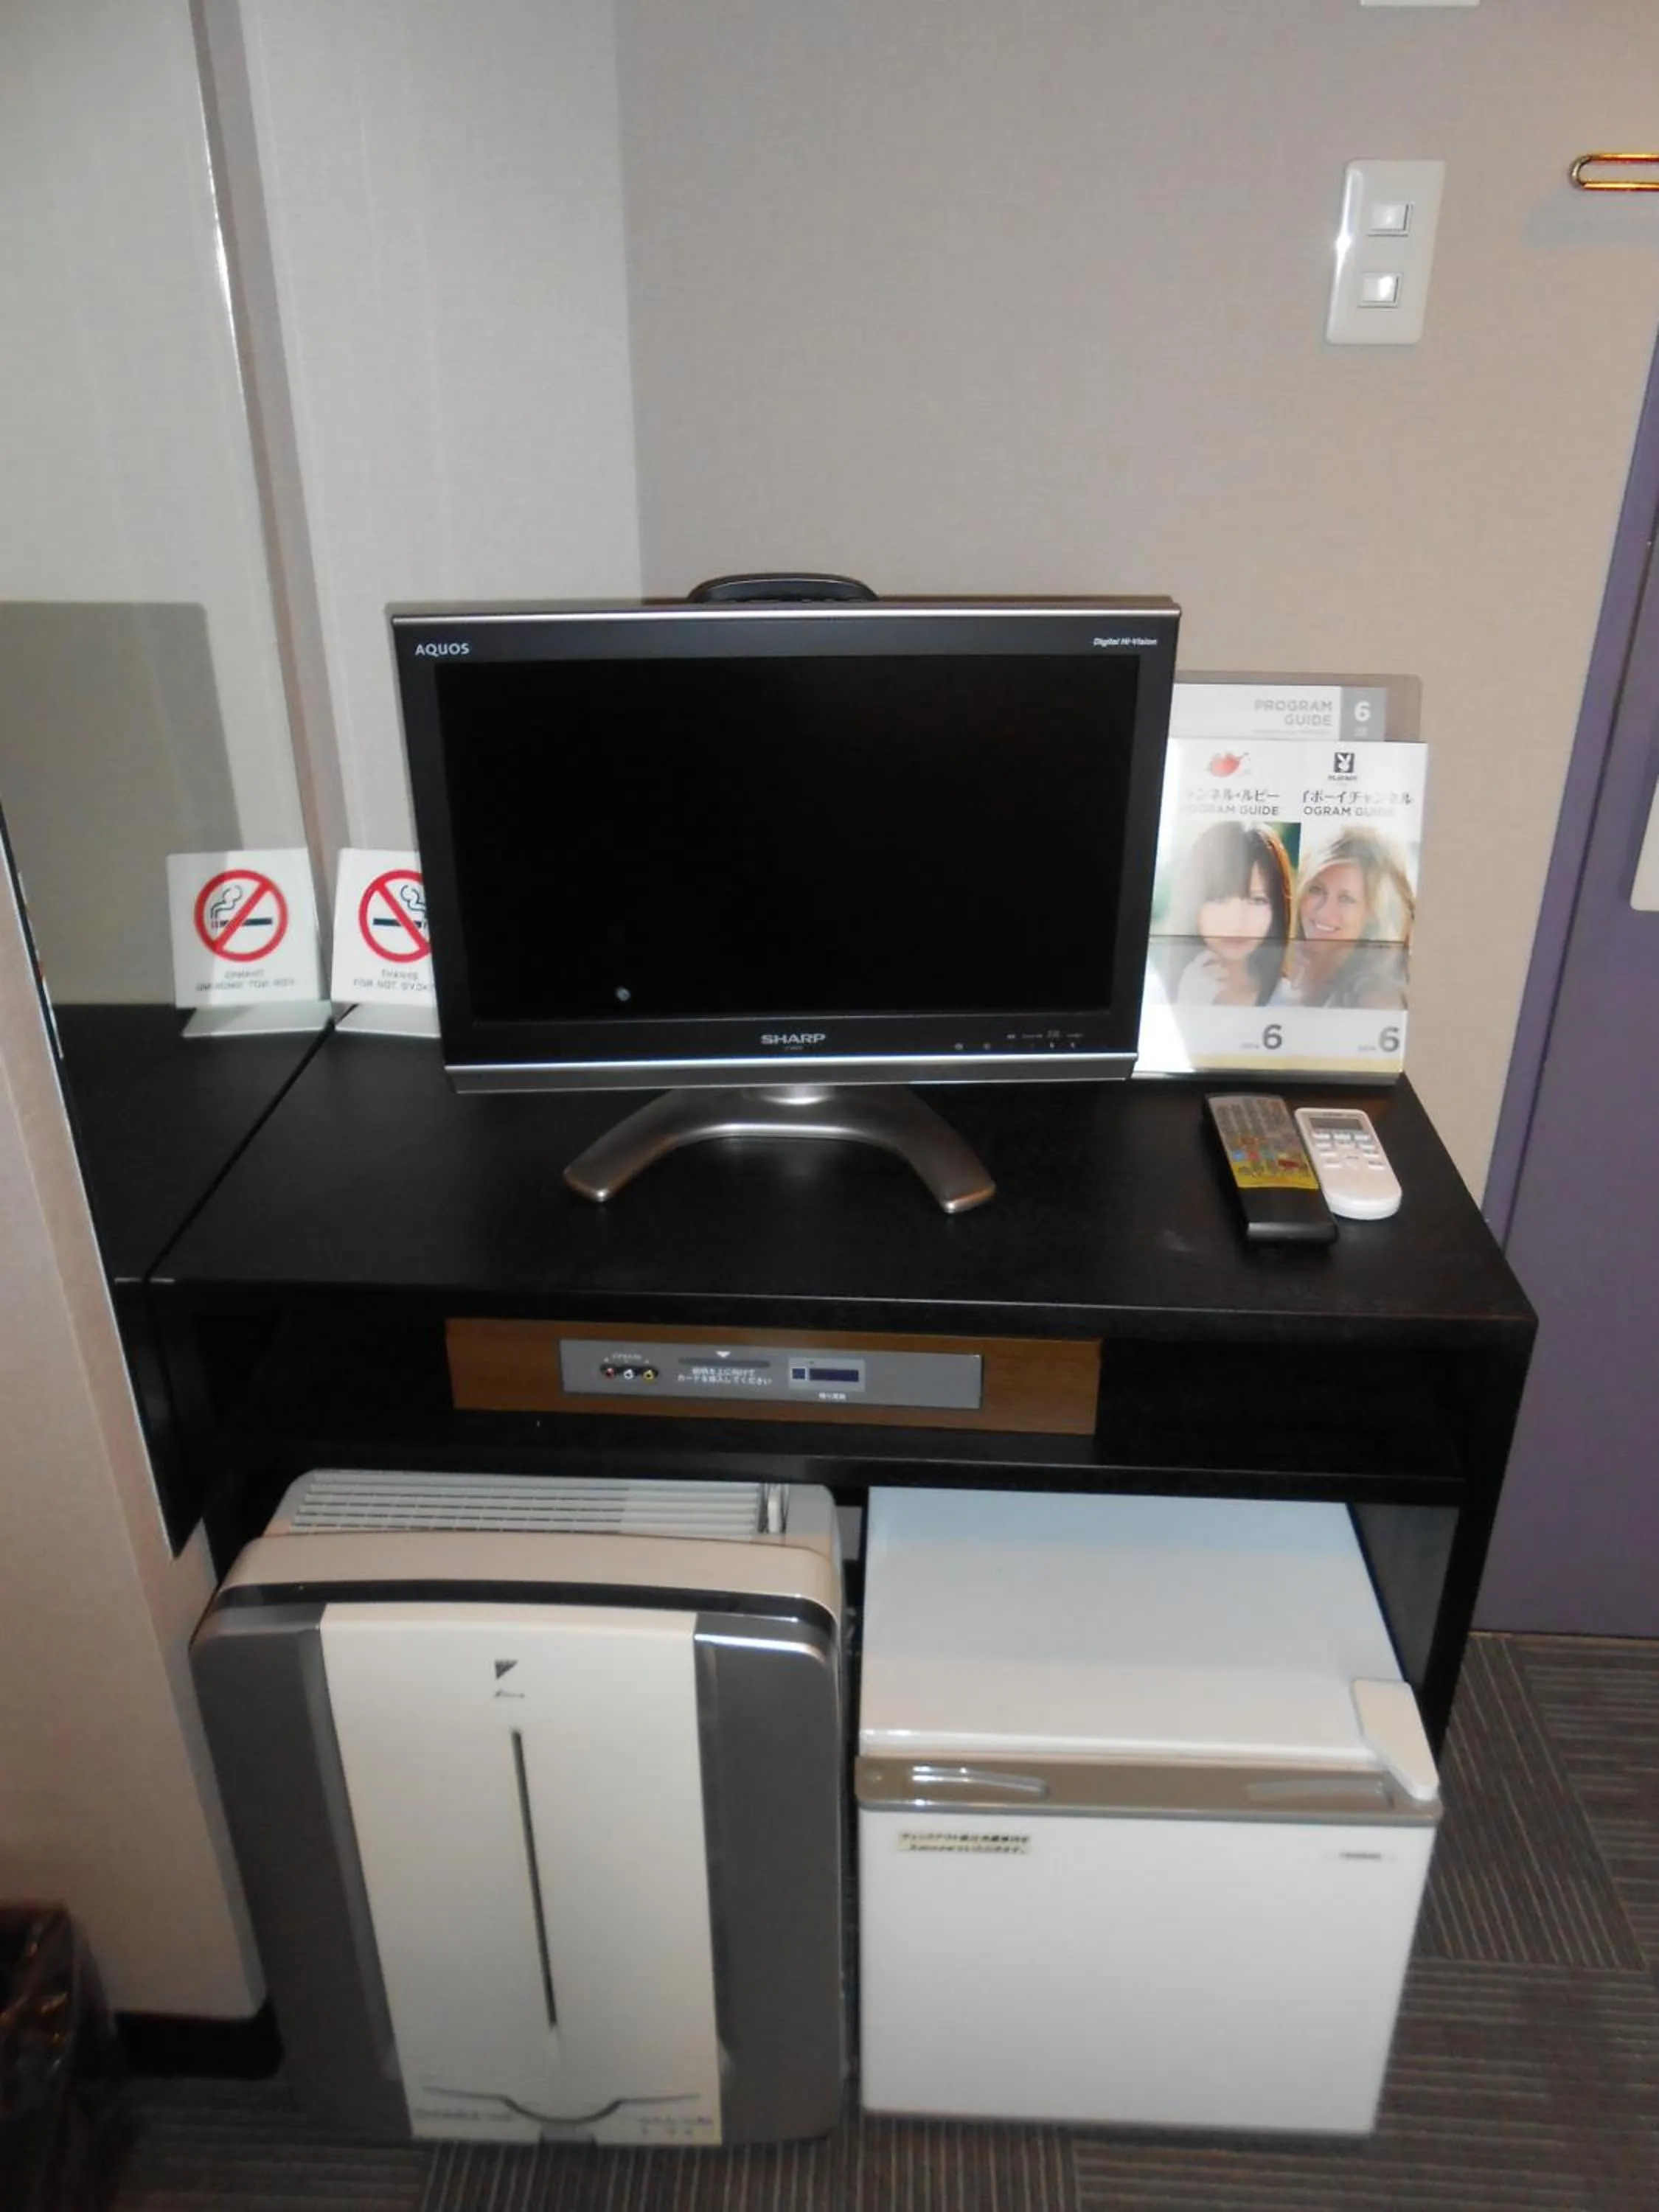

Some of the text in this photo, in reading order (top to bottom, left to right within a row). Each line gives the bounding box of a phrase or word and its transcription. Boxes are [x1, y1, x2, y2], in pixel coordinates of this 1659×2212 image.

[415, 642, 470, 658] AQUOS
[1254, 699, 1372, 723] PROGRAM 6
[1284, 713, 1334, 728] GUIDE
[1239, 805, 1281, 816] GUIDE
[760, 1033, 826, 1045] SHARP
[1262, 1023, 1283, 1051] 6
[1378, 1026, 1400, 1053] 6
